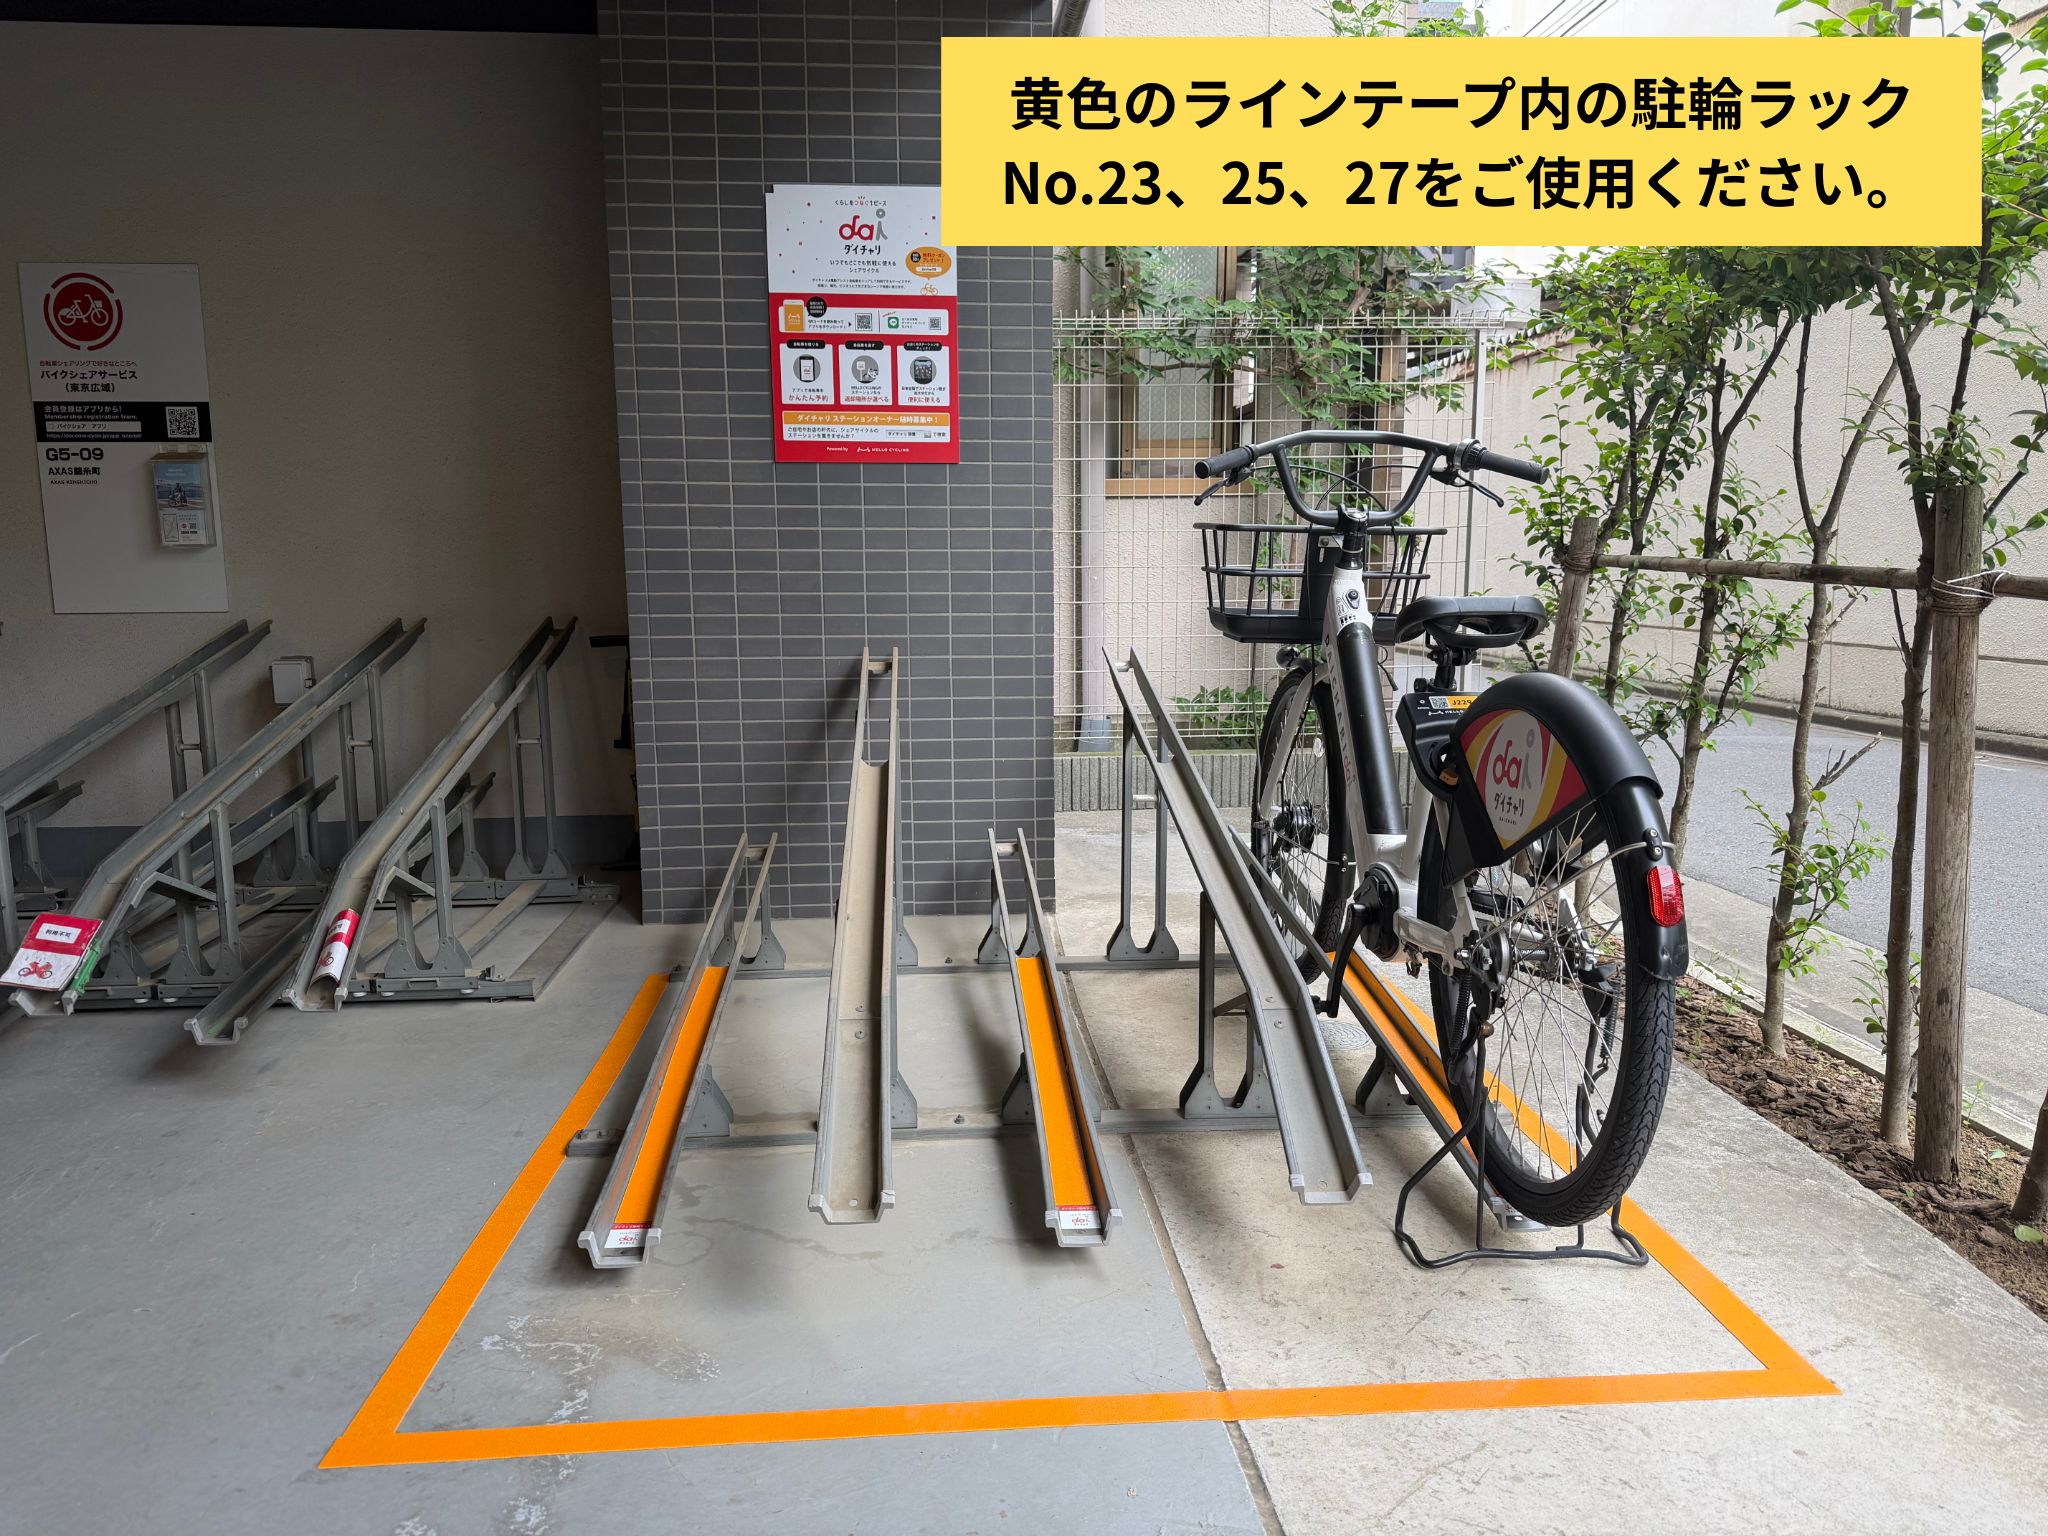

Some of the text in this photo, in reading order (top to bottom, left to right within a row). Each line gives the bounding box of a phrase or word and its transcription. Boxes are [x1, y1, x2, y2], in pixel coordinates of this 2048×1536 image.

[838, 208, 888, 242] dai
[844, 244, 881, 256] ダイチャリ
[829, 259, 897, 267] いつでもどこでも気軽に使える
[40, 369, 138, 380] バイクシェアサービス
[45, 447, 104, 461] G5-09
[1324, 632, 1347, 752] DAICHARI
[1492, 728, 1535, 790] dai
[1494, 792, 1525, 818] ダイチャリ
